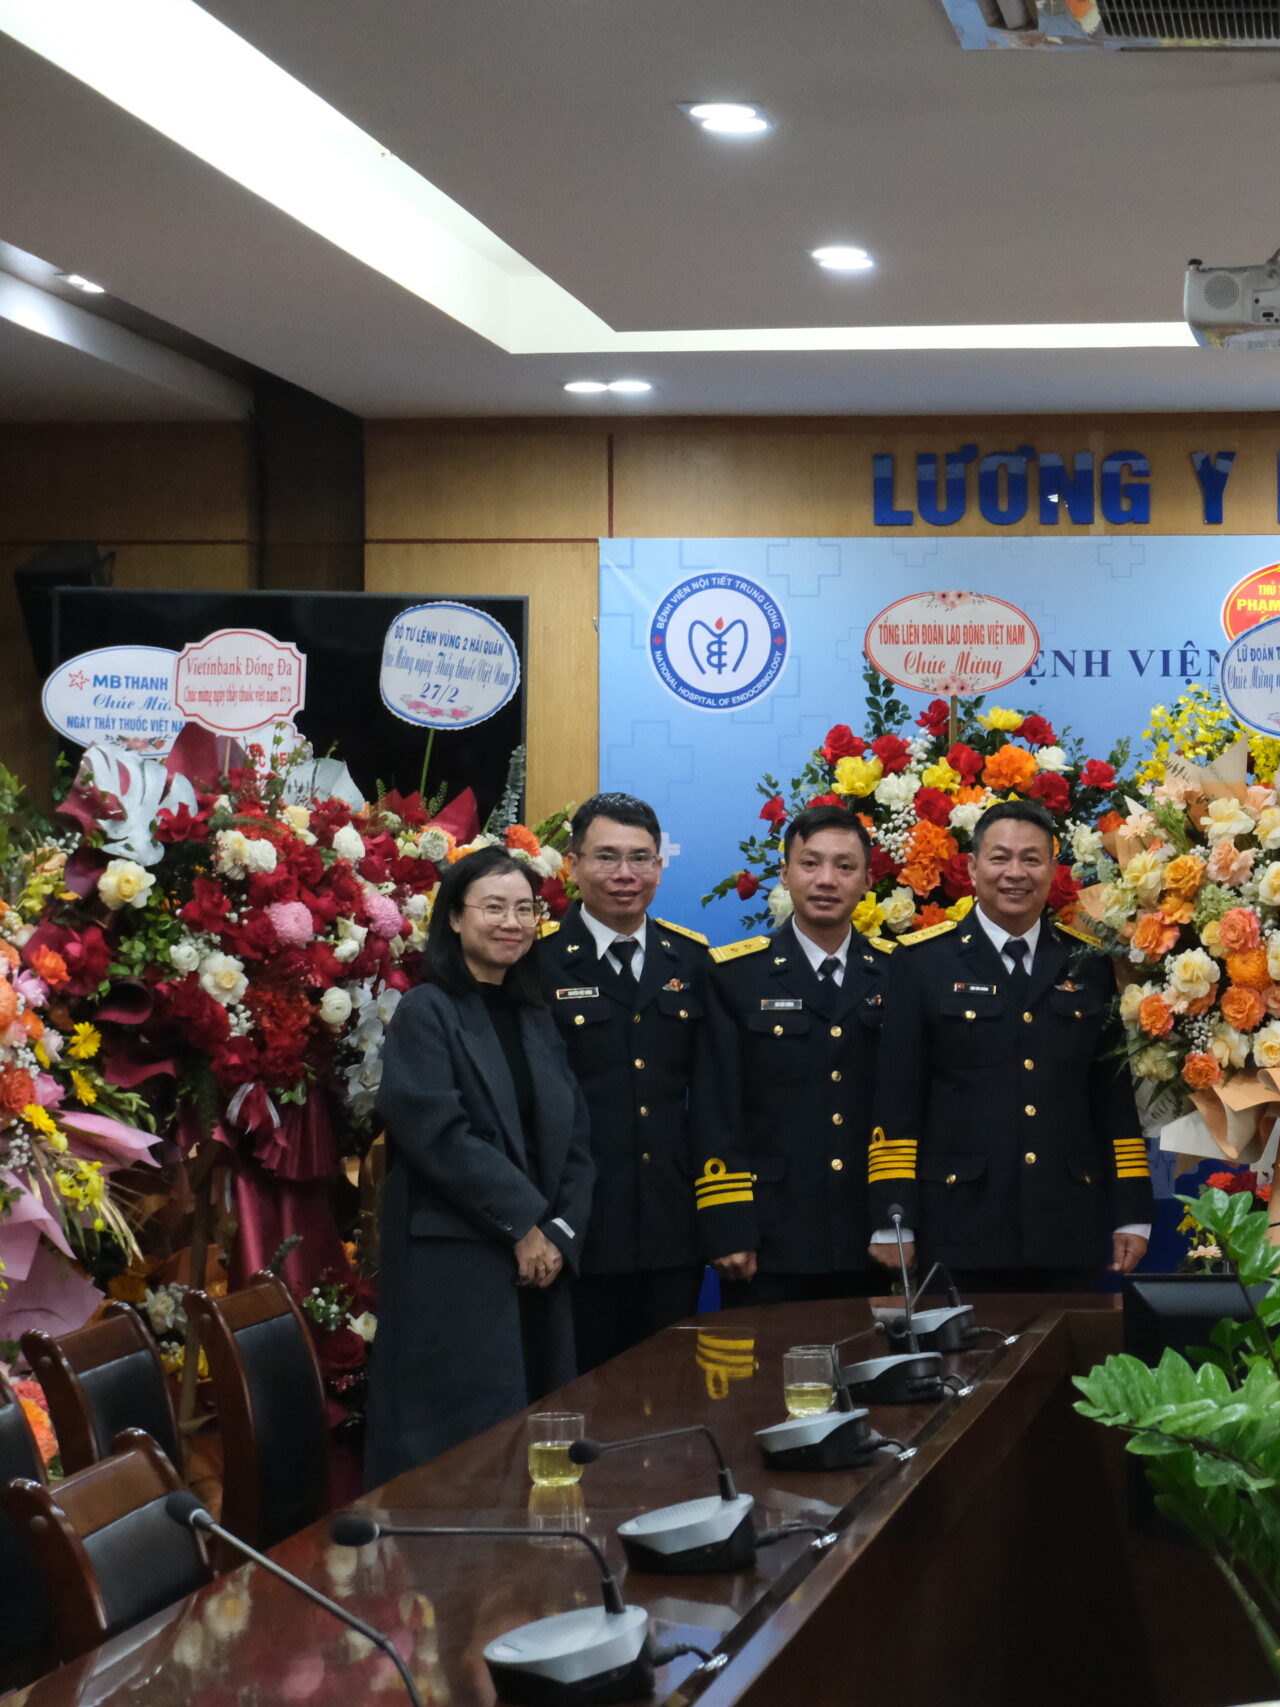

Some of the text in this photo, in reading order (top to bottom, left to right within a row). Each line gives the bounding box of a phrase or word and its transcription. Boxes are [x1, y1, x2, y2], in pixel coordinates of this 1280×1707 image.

[873, 444, 1150, 526] LƯƠNG
[1191, 451, 1236, 524] Y
[656, 575, 780, 629] BỆNH VIỆN NỘI TIẾT TRUNG ƯƠNG
[1258, 581, 1276, 596] THỦ
[405, 625, 417, 641] TƯ
[417, 626, 437, 647] LỆNH
[439, 629, 461, 649] VÙNG
[462, 638, 468, 650] 2
[483, 639, 504, 656] QUÂN
[879, 616, 1025, 650] TỔNG LIÊN ĐOÀN LAO ĐỘNG VIỆT NAM
[904, 650, 1003, 680] Chúc Mừng
[1237, 643, 1248, 662] LỮ
[1250, 643, 1274, 661] ĐOÀN
[187, 654, 292, 681] Vietinbank Đống Đa
[655, 650, 782, 706] NATIONAL HOSPITAL OF ENDOCRINOLOGY
[1024, 650, 1112, 686] ỆNH
[92, 674, 168, 691] MB THANH
[420, 682, 459, 705] 27/2
[93, 693, 135, 709] Chúc
[66, 713, 186, 733] NGÀY THẦY THUỐC VIỆT NA
